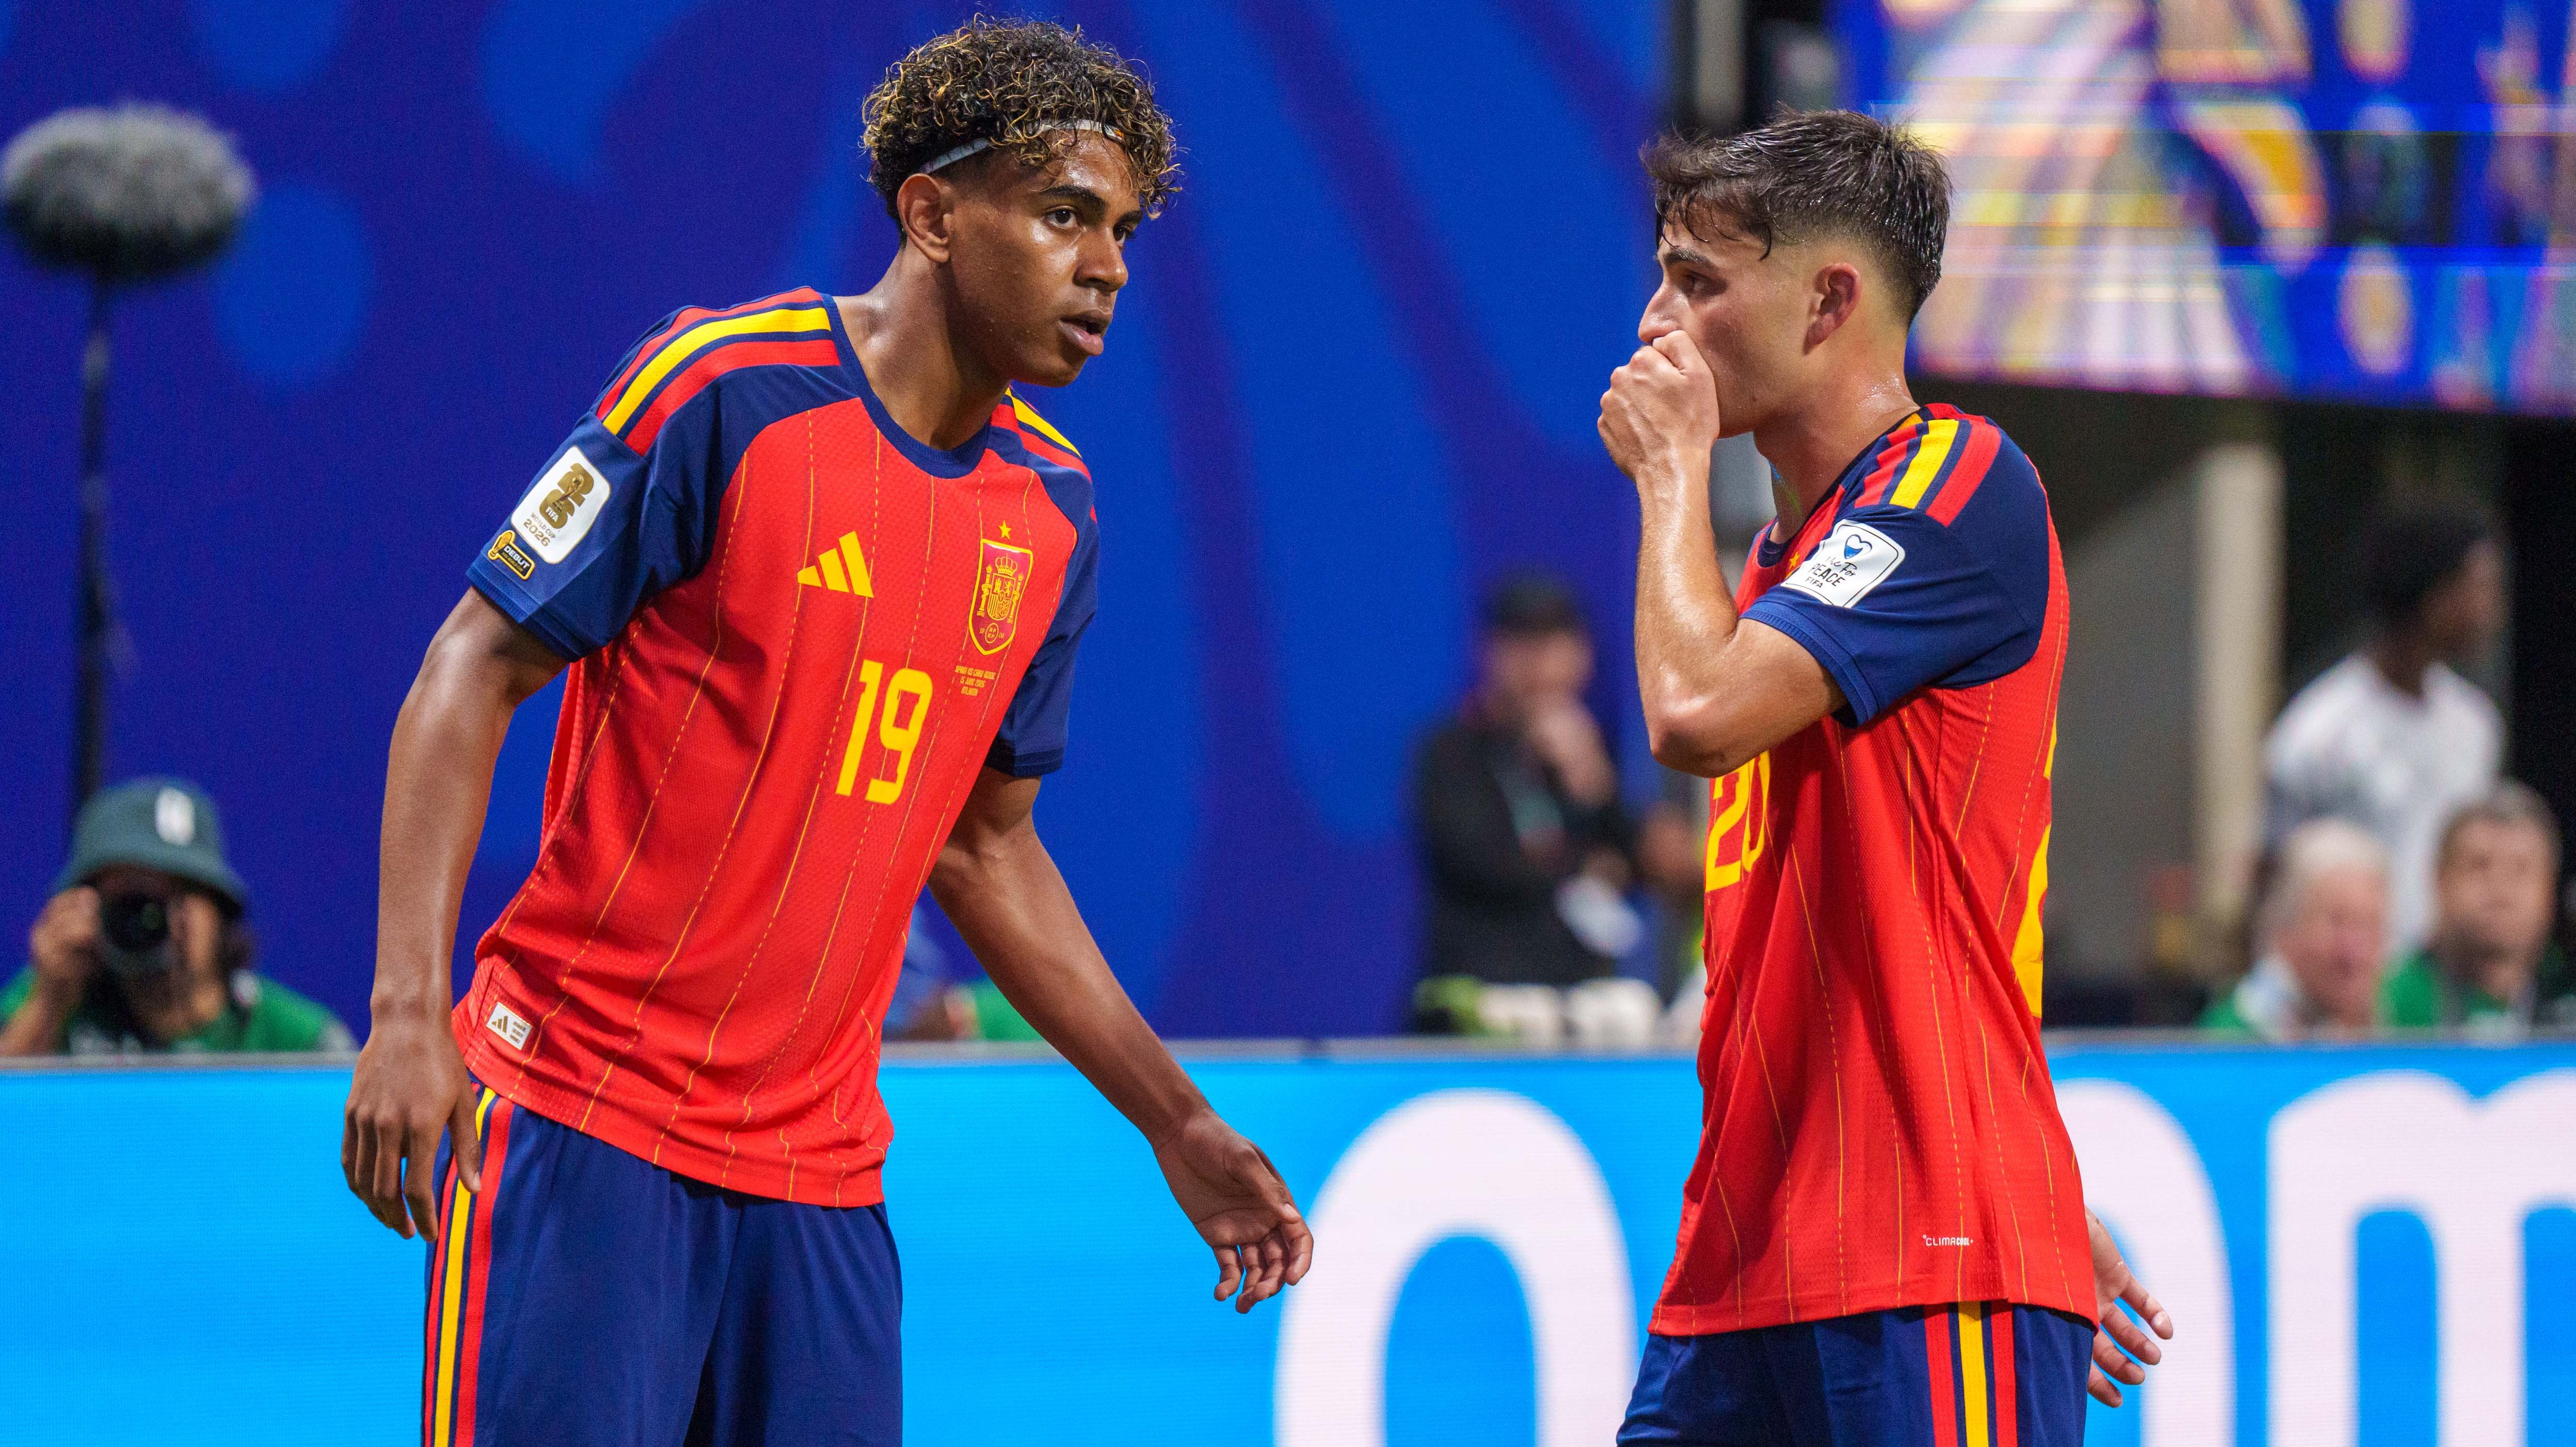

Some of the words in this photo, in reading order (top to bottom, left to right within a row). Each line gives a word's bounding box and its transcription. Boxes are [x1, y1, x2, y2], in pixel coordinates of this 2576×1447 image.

[530, 512, 547, 530] WORLD
[545, 528, 556, 539] CUP
[545, 506, 559, 523] FIFA
[523, 518, 551, 547] 2026
[503, 545, 531, 569] DEBUT
[1839, 562, 1857, 576] For
[1805, 577, 1823, 588] FIFA
[1807, 563, 1846, 586] PEACE
[835, 659, 933, 805] 19
[1705, 750, 1770, 893] 20
